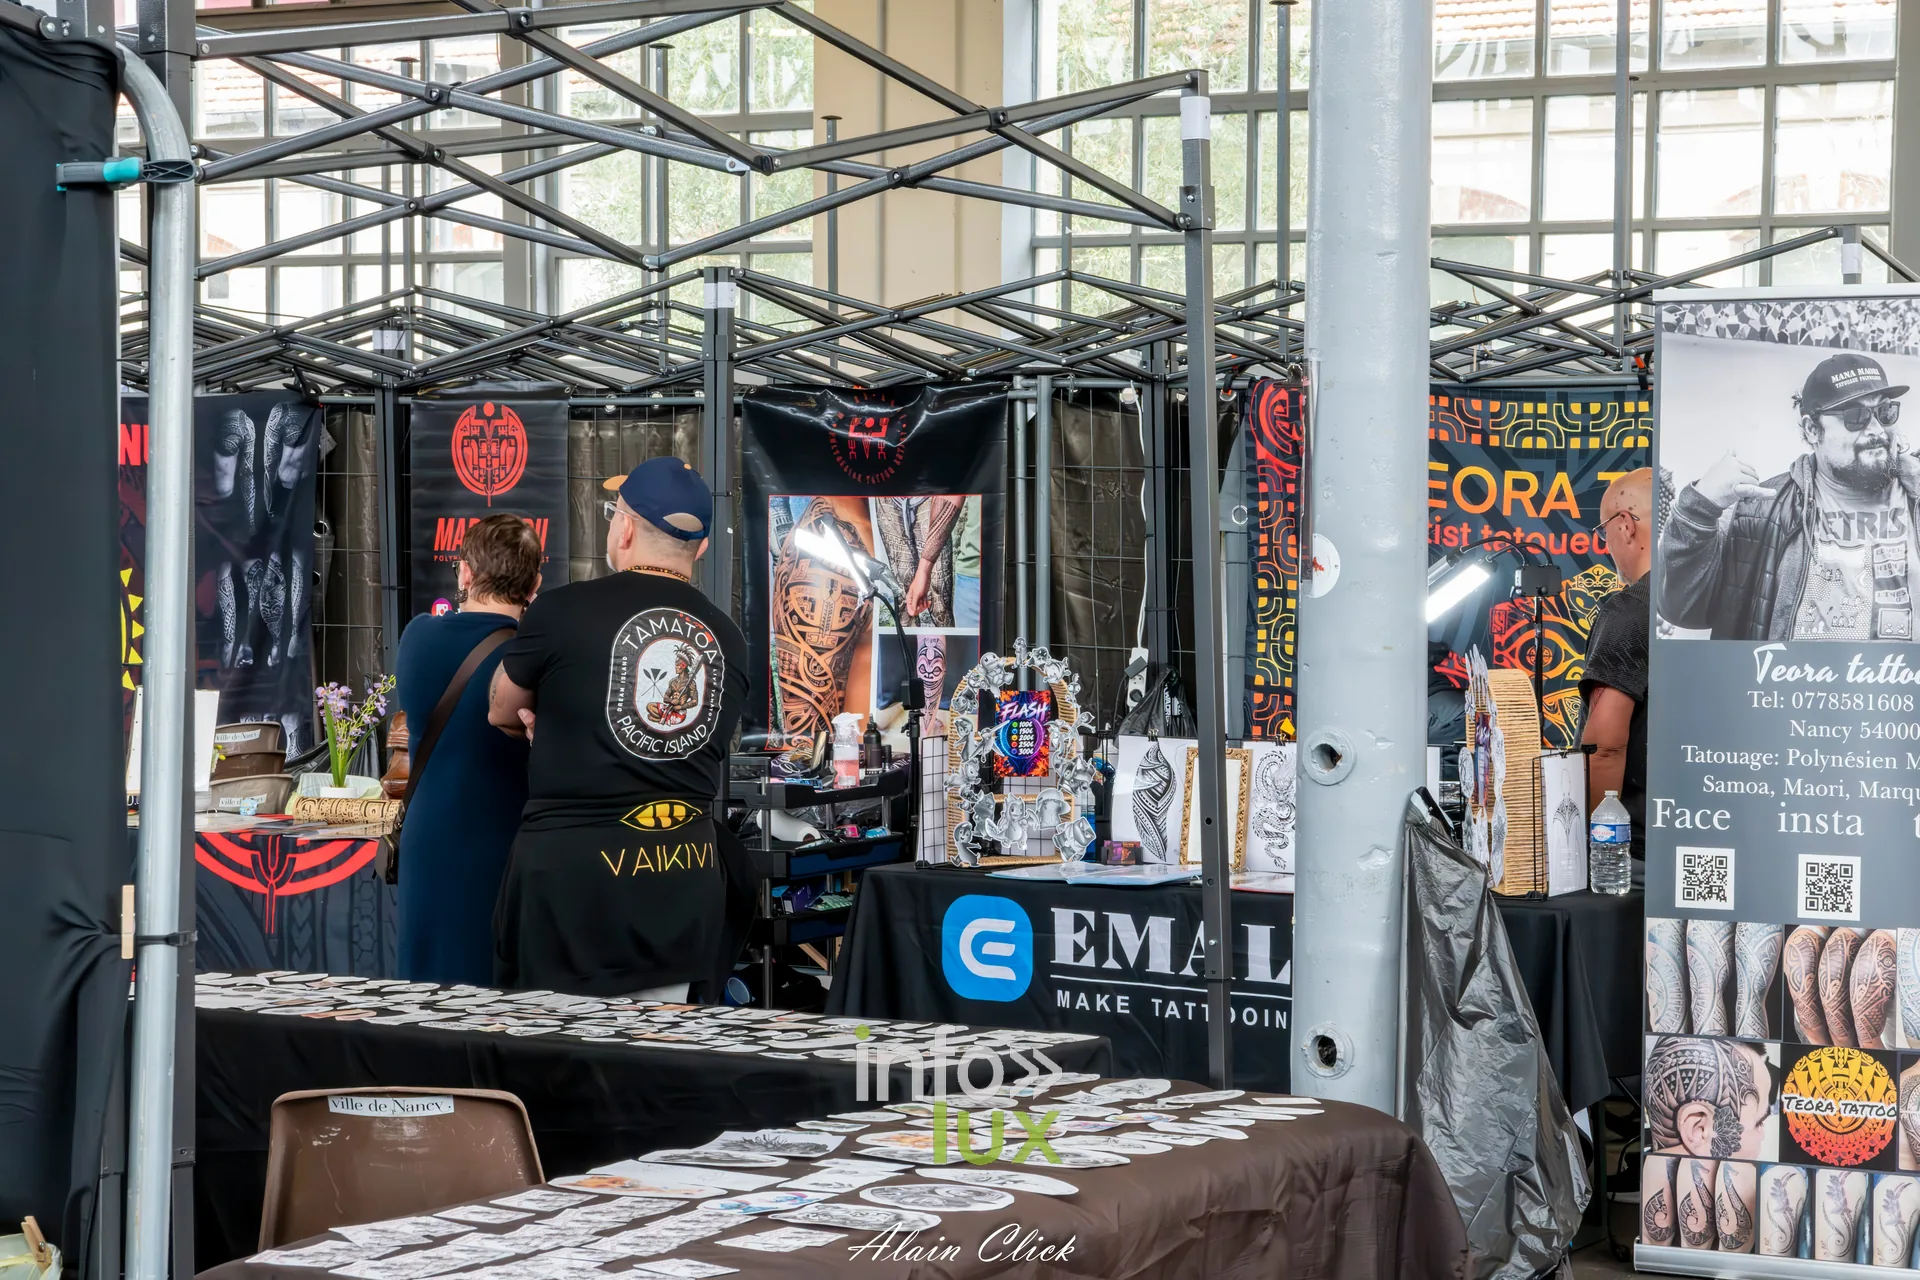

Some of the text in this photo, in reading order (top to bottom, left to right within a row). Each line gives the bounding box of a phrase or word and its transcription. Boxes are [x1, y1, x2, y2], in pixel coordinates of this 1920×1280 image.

[1831, 370, 1857, 384] MANA
[622, 616, 719, 664] TAMATOA
[1753, 643, 1839, 685] Teora
[617, 656, 628, 712] DREAM ISLAND
[1000, 701, 1047, 721] FLASH
[1747, 691, 1914, 712] Tel: 0778581608
[617, 715, 707, 754] PACIFIC ISLAND
[1789, 720, 1920, 743] Nancy 54000
[1681, 745, 1779, 771] Tatouage:
[1786, 748, 1897, 773] Polynésien
[1703, 775, 1775, 797] Samoa,
[1783, 778, 1850, 800] Maori,
[1652, 798, 1731, 830] Face
[1778, 801, 1864, 836] insta
[601, 843, 714, 876] VAIKIVI
[1056, 989, 1131, 1014] MAKE
[368, 1099, 387, 1112] de
[391, 1098, 444, 1113] Nancy
